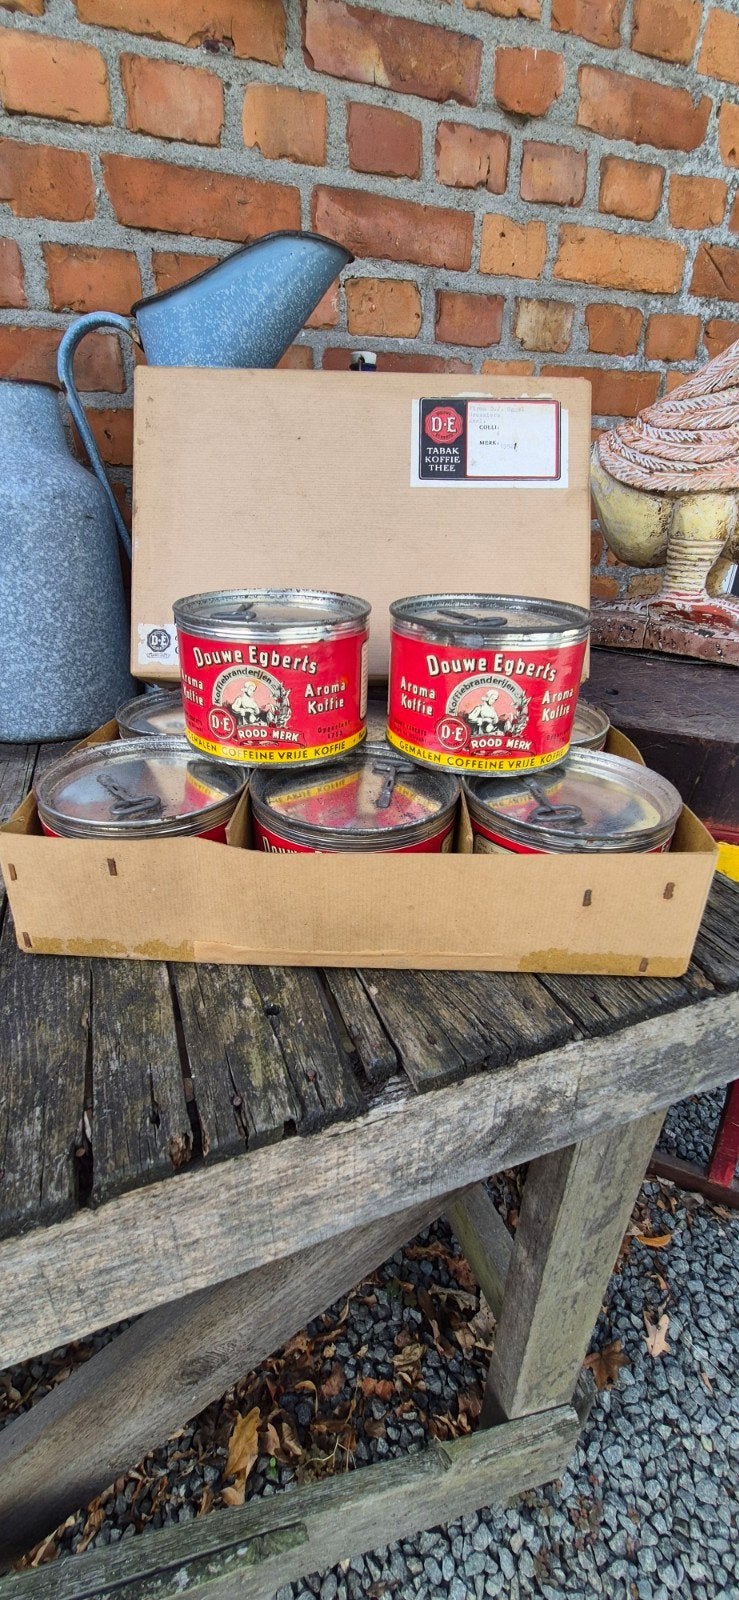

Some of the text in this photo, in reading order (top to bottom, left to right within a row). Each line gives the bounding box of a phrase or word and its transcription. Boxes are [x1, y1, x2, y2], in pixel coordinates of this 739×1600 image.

[424, 455, 461, 464] KOFFIE
[426, 447, 460, 455] TABAK
[428, 464, 456, 472] THEE
[193, 645, 318, 675] Douwe Egberts
[426, 653, 557, 682] Douwe Egberts
[214, 667, 272, 704] Koffiebranderijen
[304, 681, 346, 698] Aroma
[400, 676, 436, 700] Aroma
[449, 676, 516, 713] Koffiebranderijen
[401, 693, 434, 716] Koffie
[541, 688, 574, 705] Aroma
[307, 698, 345, 715] Koffie
[237, 729, 268, 739] ROOD
[272, 729, 300, 742] MERK
[471, 738, 532, 751] ROOD MERK
[221, 746, 274, 760] COFFEINE
[277, 750, 308, 760] VRIJE
[314, 741, 346, 756] KOFFIE
[399, 740, 441, 763] GEMALEN
[447, 755, 504, 770] COFFEINE
[508, 758, 536, 769] VRIJE
